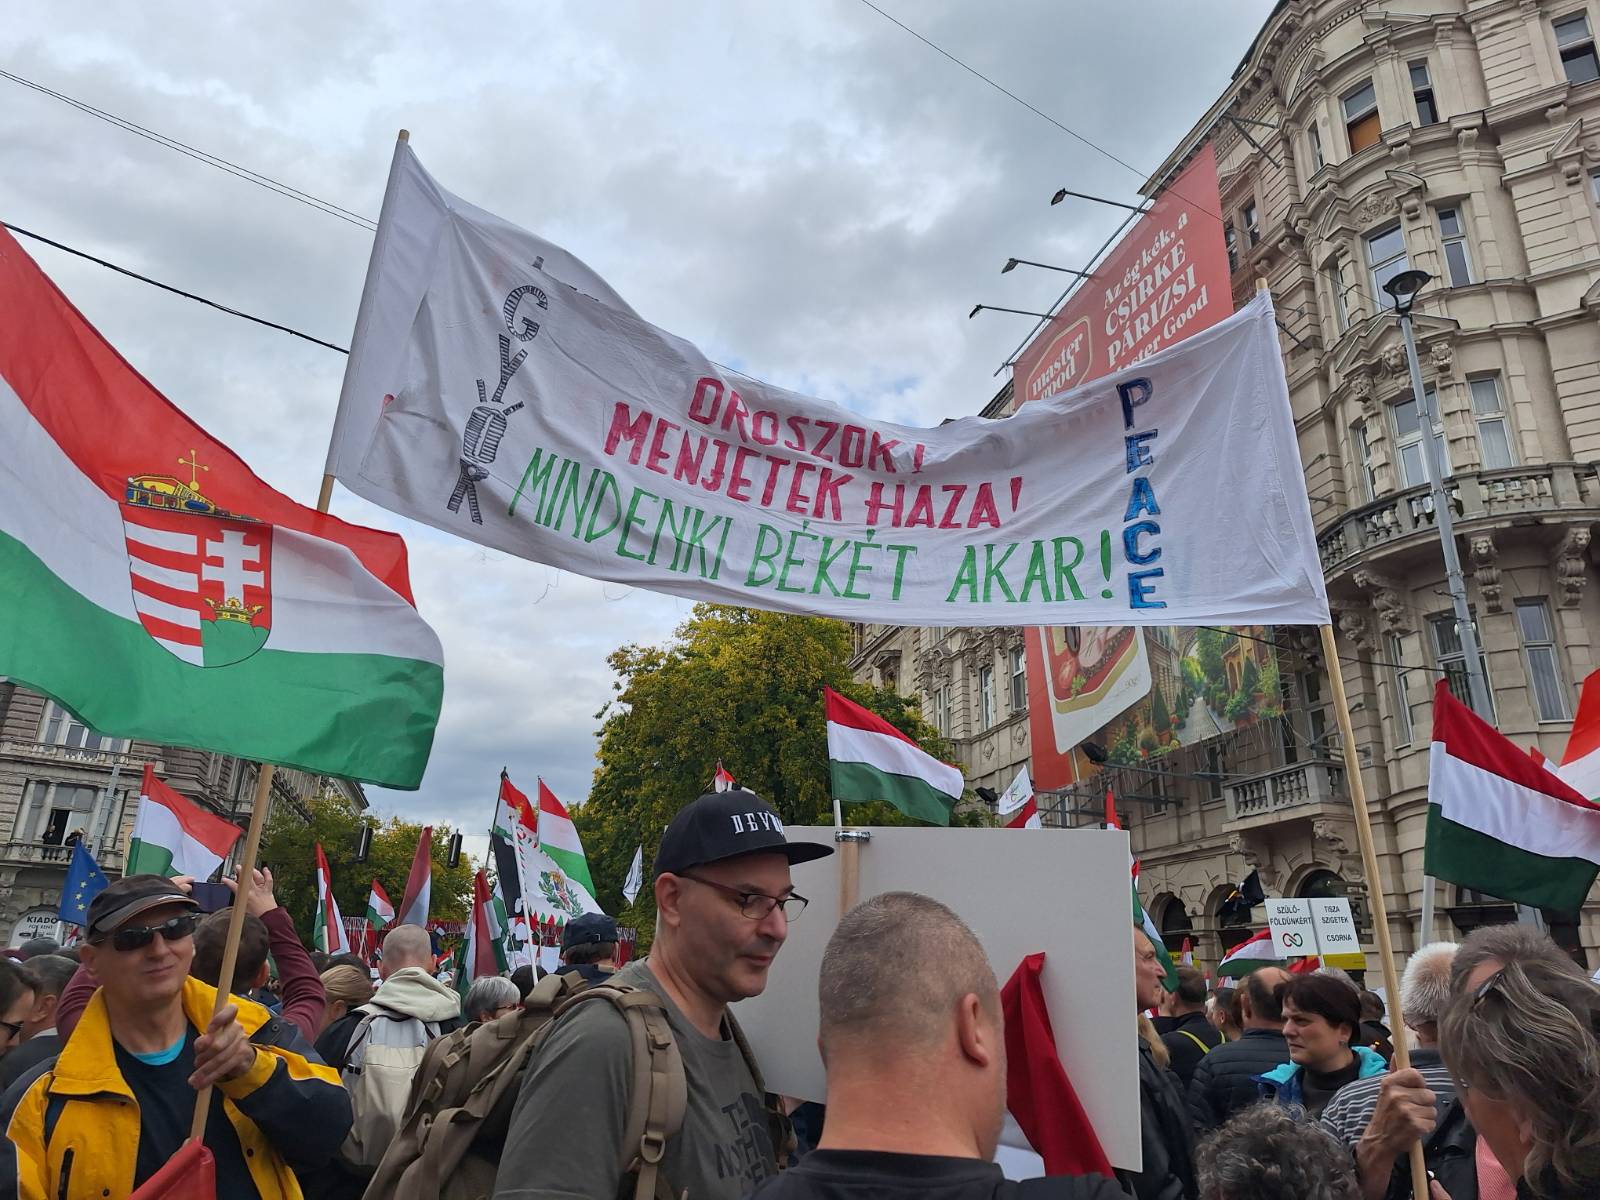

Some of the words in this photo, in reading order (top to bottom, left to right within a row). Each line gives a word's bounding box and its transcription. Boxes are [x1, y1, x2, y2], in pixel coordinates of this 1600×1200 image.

[1104, 283, 1121, 310] Az
[1123, 260, 1140, 288] ég
[1142, 230, 1176, 268] kék,
[1178, 213, 1188, 230] a
[1105, 239, 1186, 336] CSIRKE
[1107, 264, 1197, 368] PÁRIZSI
[1163, 284, 1208, 340] Good
[1032, 333, 1083, 397] master
[604, 401, 854, 521] MENJETEK
[864, 476, 1022, 529] HAZA!
[687, 376, 926, 475] OROSZOK!
[508, 447, 732, 580] MINDENKI
[746, 518, 918, 600] BÉKÉT
[946, 530, 1113, 603] AKAR!
[1116, 376, 1168, 610] PEACE
[1270, 916, 1312, 926] FÖLDÜNKÉRT
[1324, 905, 1340, 913] TISZA
[1326, 934, 1353, 942] CSORNA
